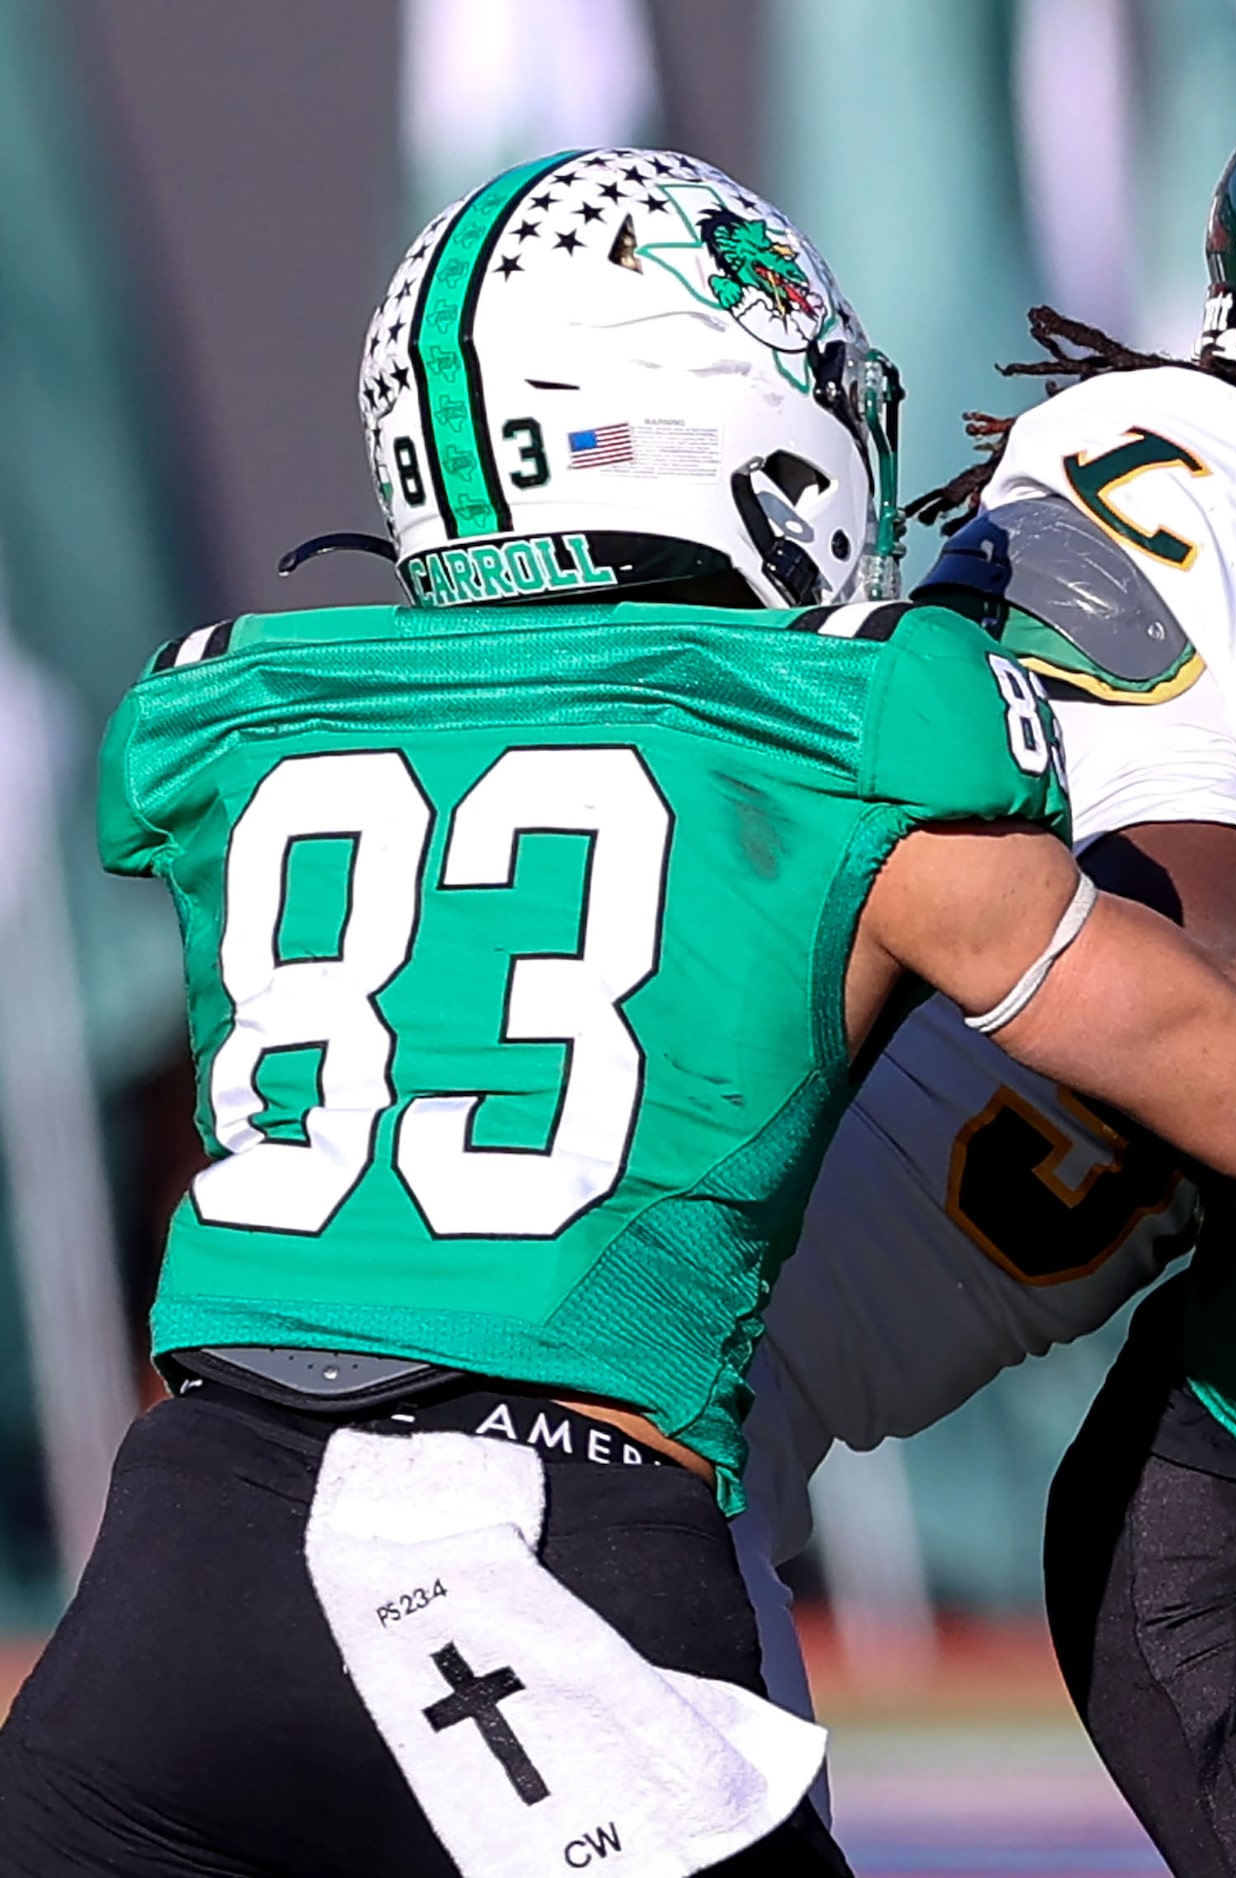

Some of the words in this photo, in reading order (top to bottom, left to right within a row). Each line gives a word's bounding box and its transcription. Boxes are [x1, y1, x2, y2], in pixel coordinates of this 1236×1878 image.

[393, 436, 426, 508] 8
[502, 417, 551, 490] 3
[1062, 426, 1210, 572] L
[408, 534, 618, 607] CARROLL
[188, 744, 676, 1241] 83
[564, 1821, 622, 1868] CW
